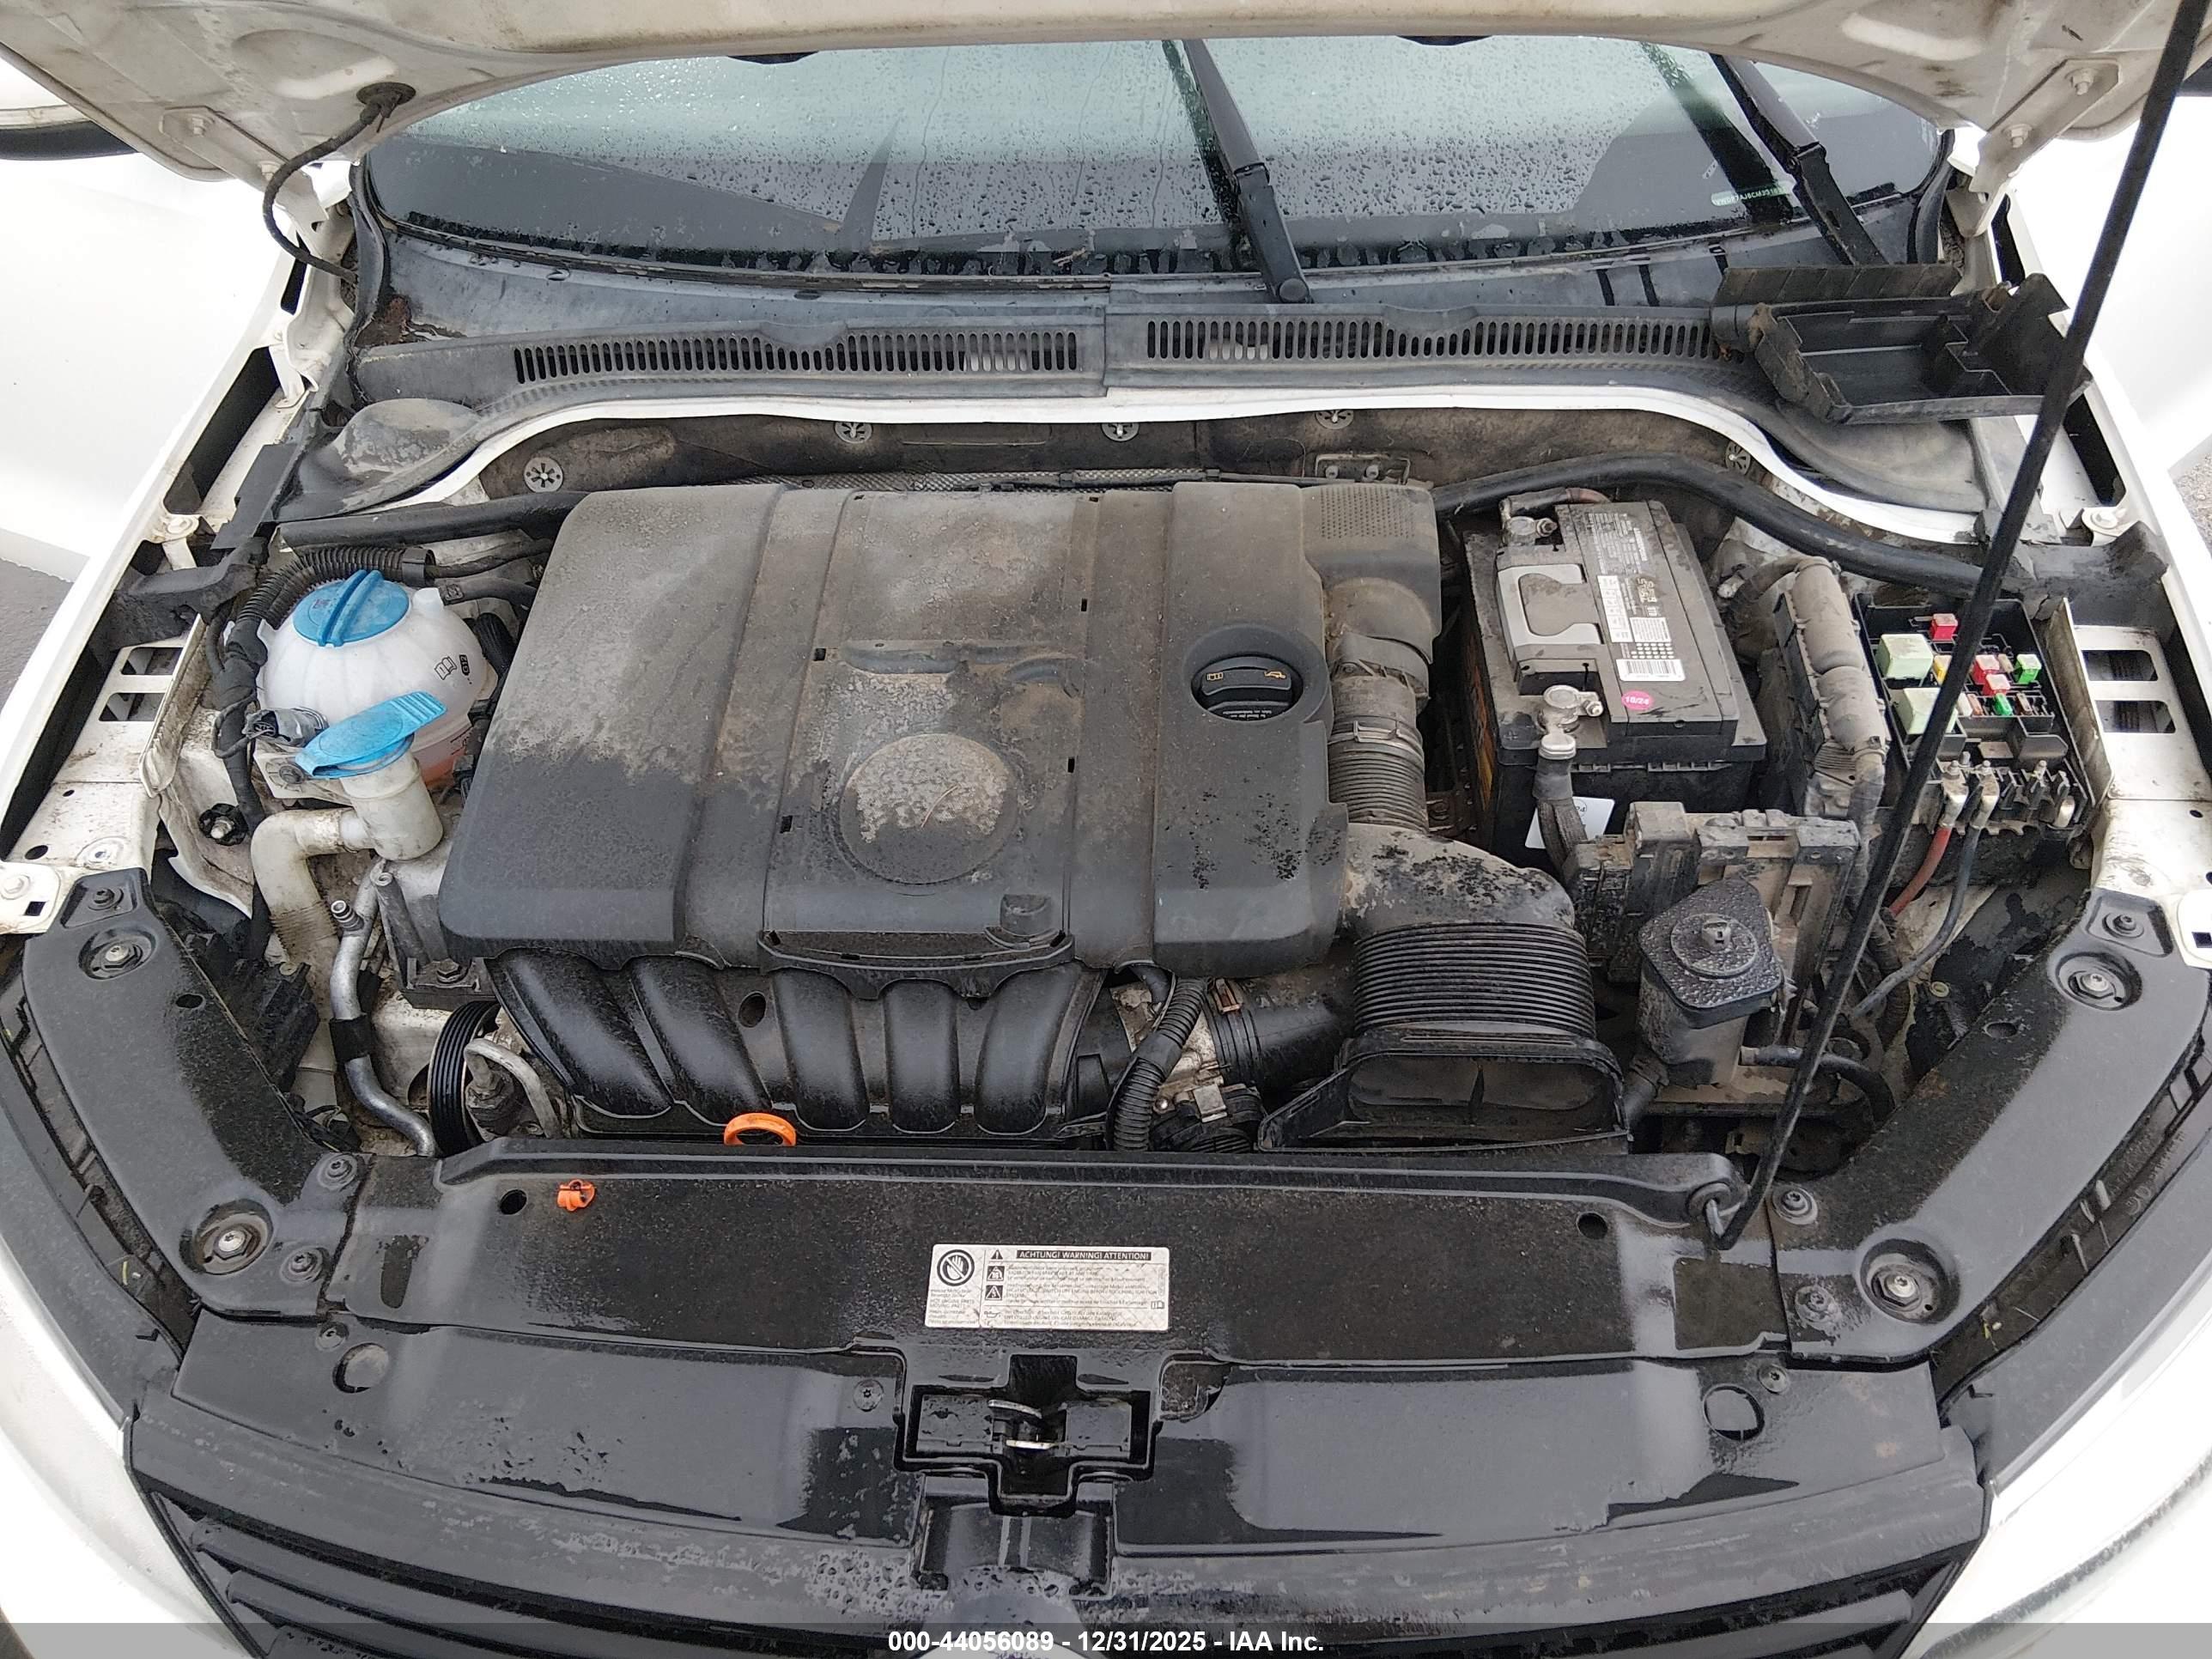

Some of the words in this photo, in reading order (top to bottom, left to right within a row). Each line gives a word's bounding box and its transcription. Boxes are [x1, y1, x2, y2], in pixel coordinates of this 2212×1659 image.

[459, 655, 470, 674] G12
[1019, 1251, 1061, 1260] ACHTUNG!
[1061, 1251, 1103, 1260] WARNING!
[1103, 1252, 1150, 1261] ATTENTION!
